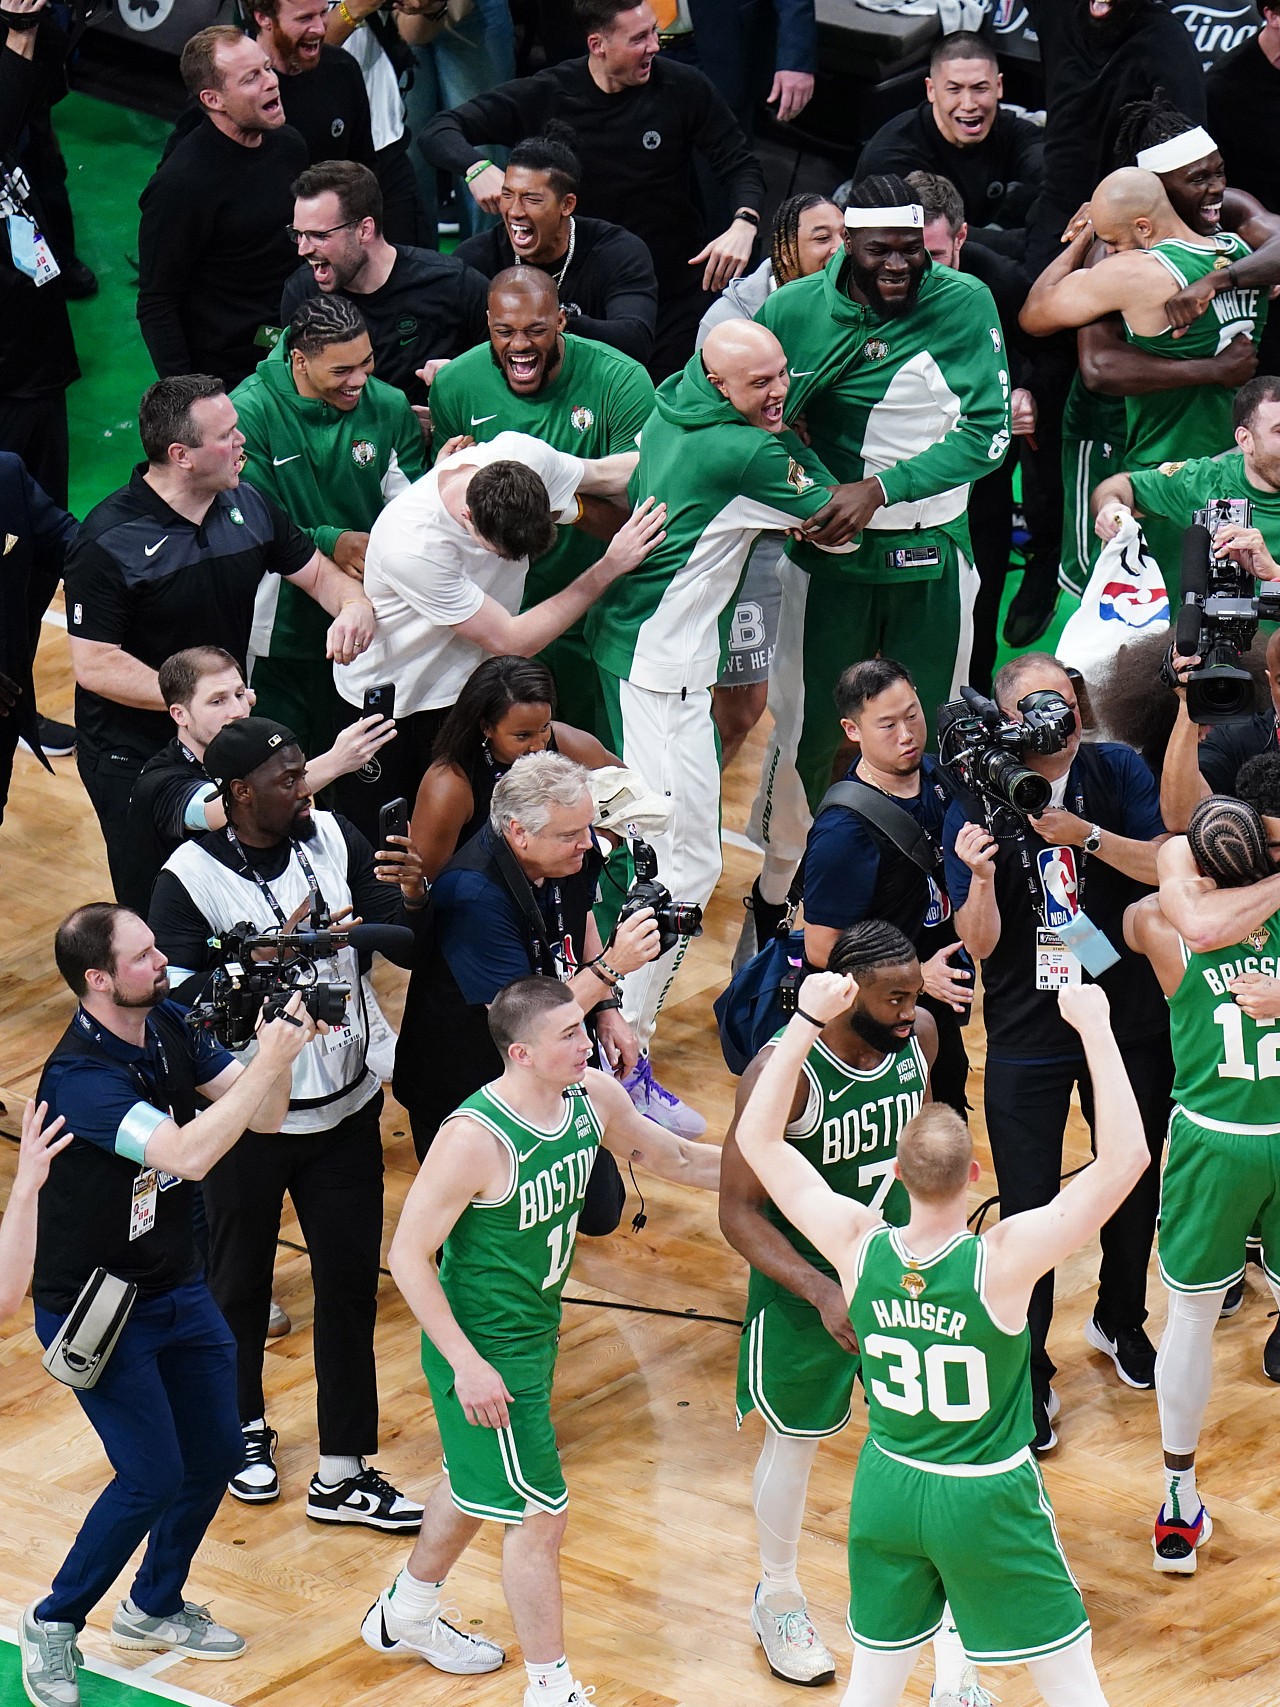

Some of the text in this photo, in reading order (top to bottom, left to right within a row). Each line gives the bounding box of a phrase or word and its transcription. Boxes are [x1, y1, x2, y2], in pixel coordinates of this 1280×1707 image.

[1211, 289, 1259, 324] WHITE
[766, 745, 781, 799] BOSTON
[1050, 910, 1068, 926] NBA
[895, 1057, 916, 1075] VISTA
[898, 1068, 918, 1085] PRINT
[858, 1157, 898, 1220] 7
[901, 1276, 925, 1288] Finals
[871, 1299, 968, 1341] HAUSER
[864, 1333, 991, 1422] 30
